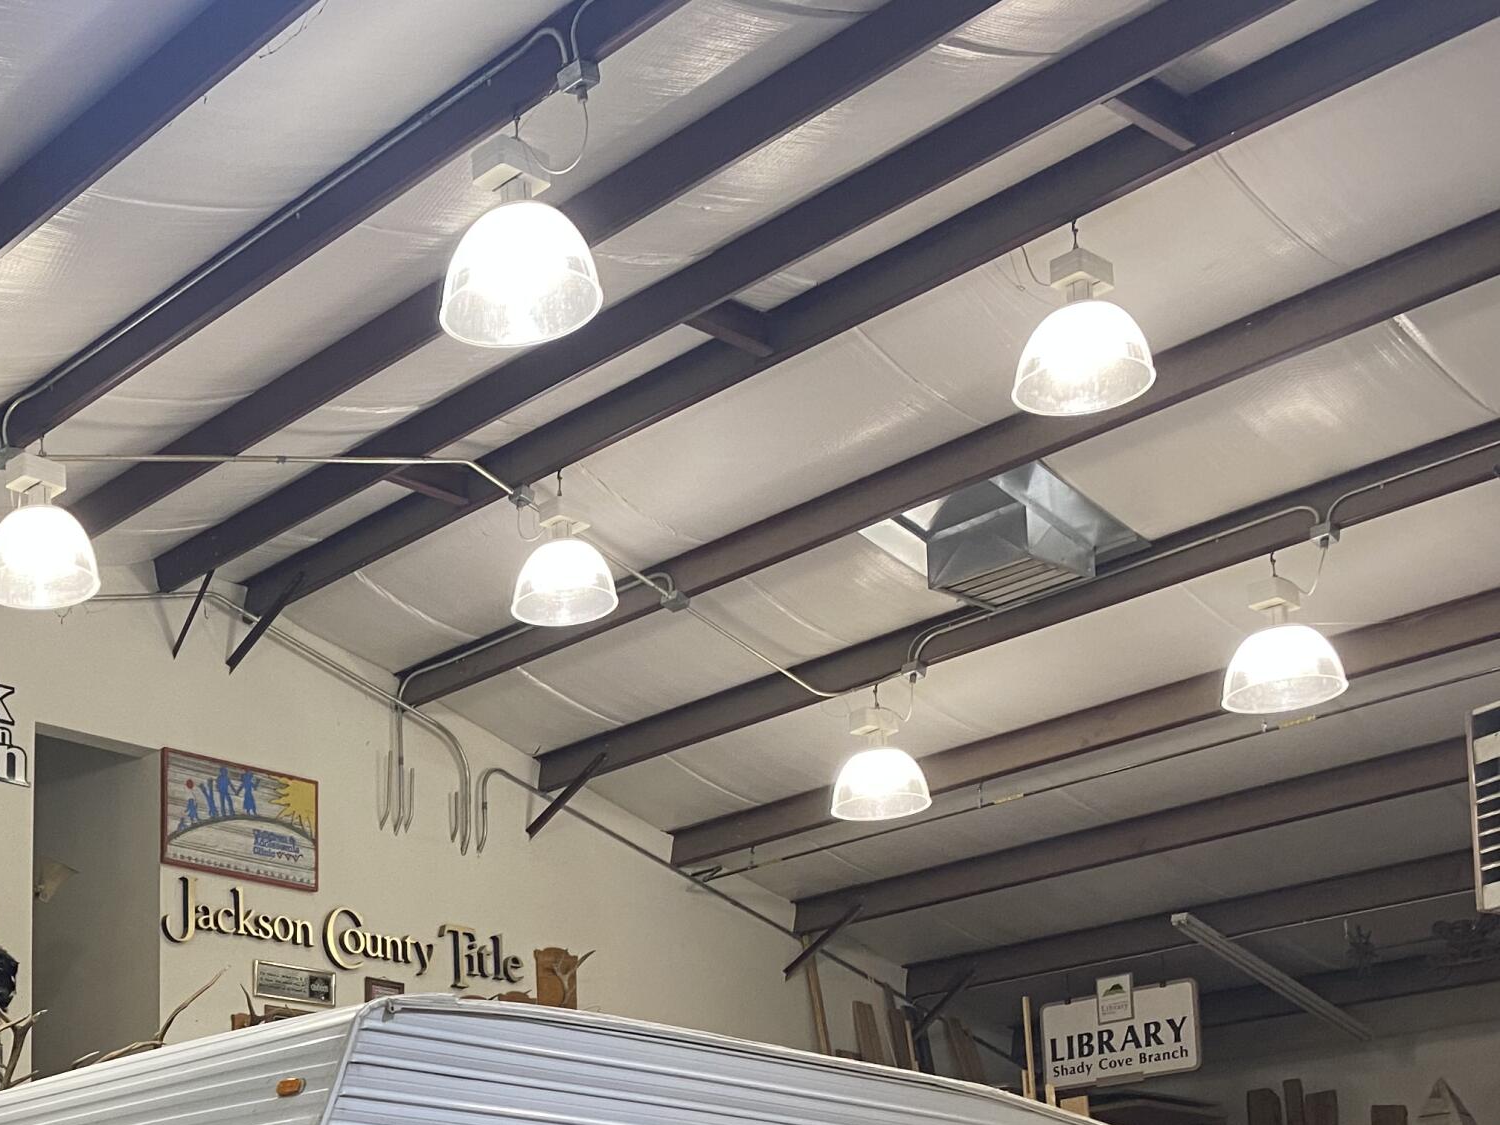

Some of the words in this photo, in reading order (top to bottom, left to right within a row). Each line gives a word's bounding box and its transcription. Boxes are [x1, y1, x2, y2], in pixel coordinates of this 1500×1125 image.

[162, 876, 314, 948] Jackson
[323, 905, 434, 976] County
[437, 923, 525, 989] Title
[1050, 1015, 1188, 1063] LIBRARY
[1052, 1062, 1093, 1078] Shady
[1098, 1055, 1133, 1070] Cove
[1138, 1046, 1189, 1065] Branch
